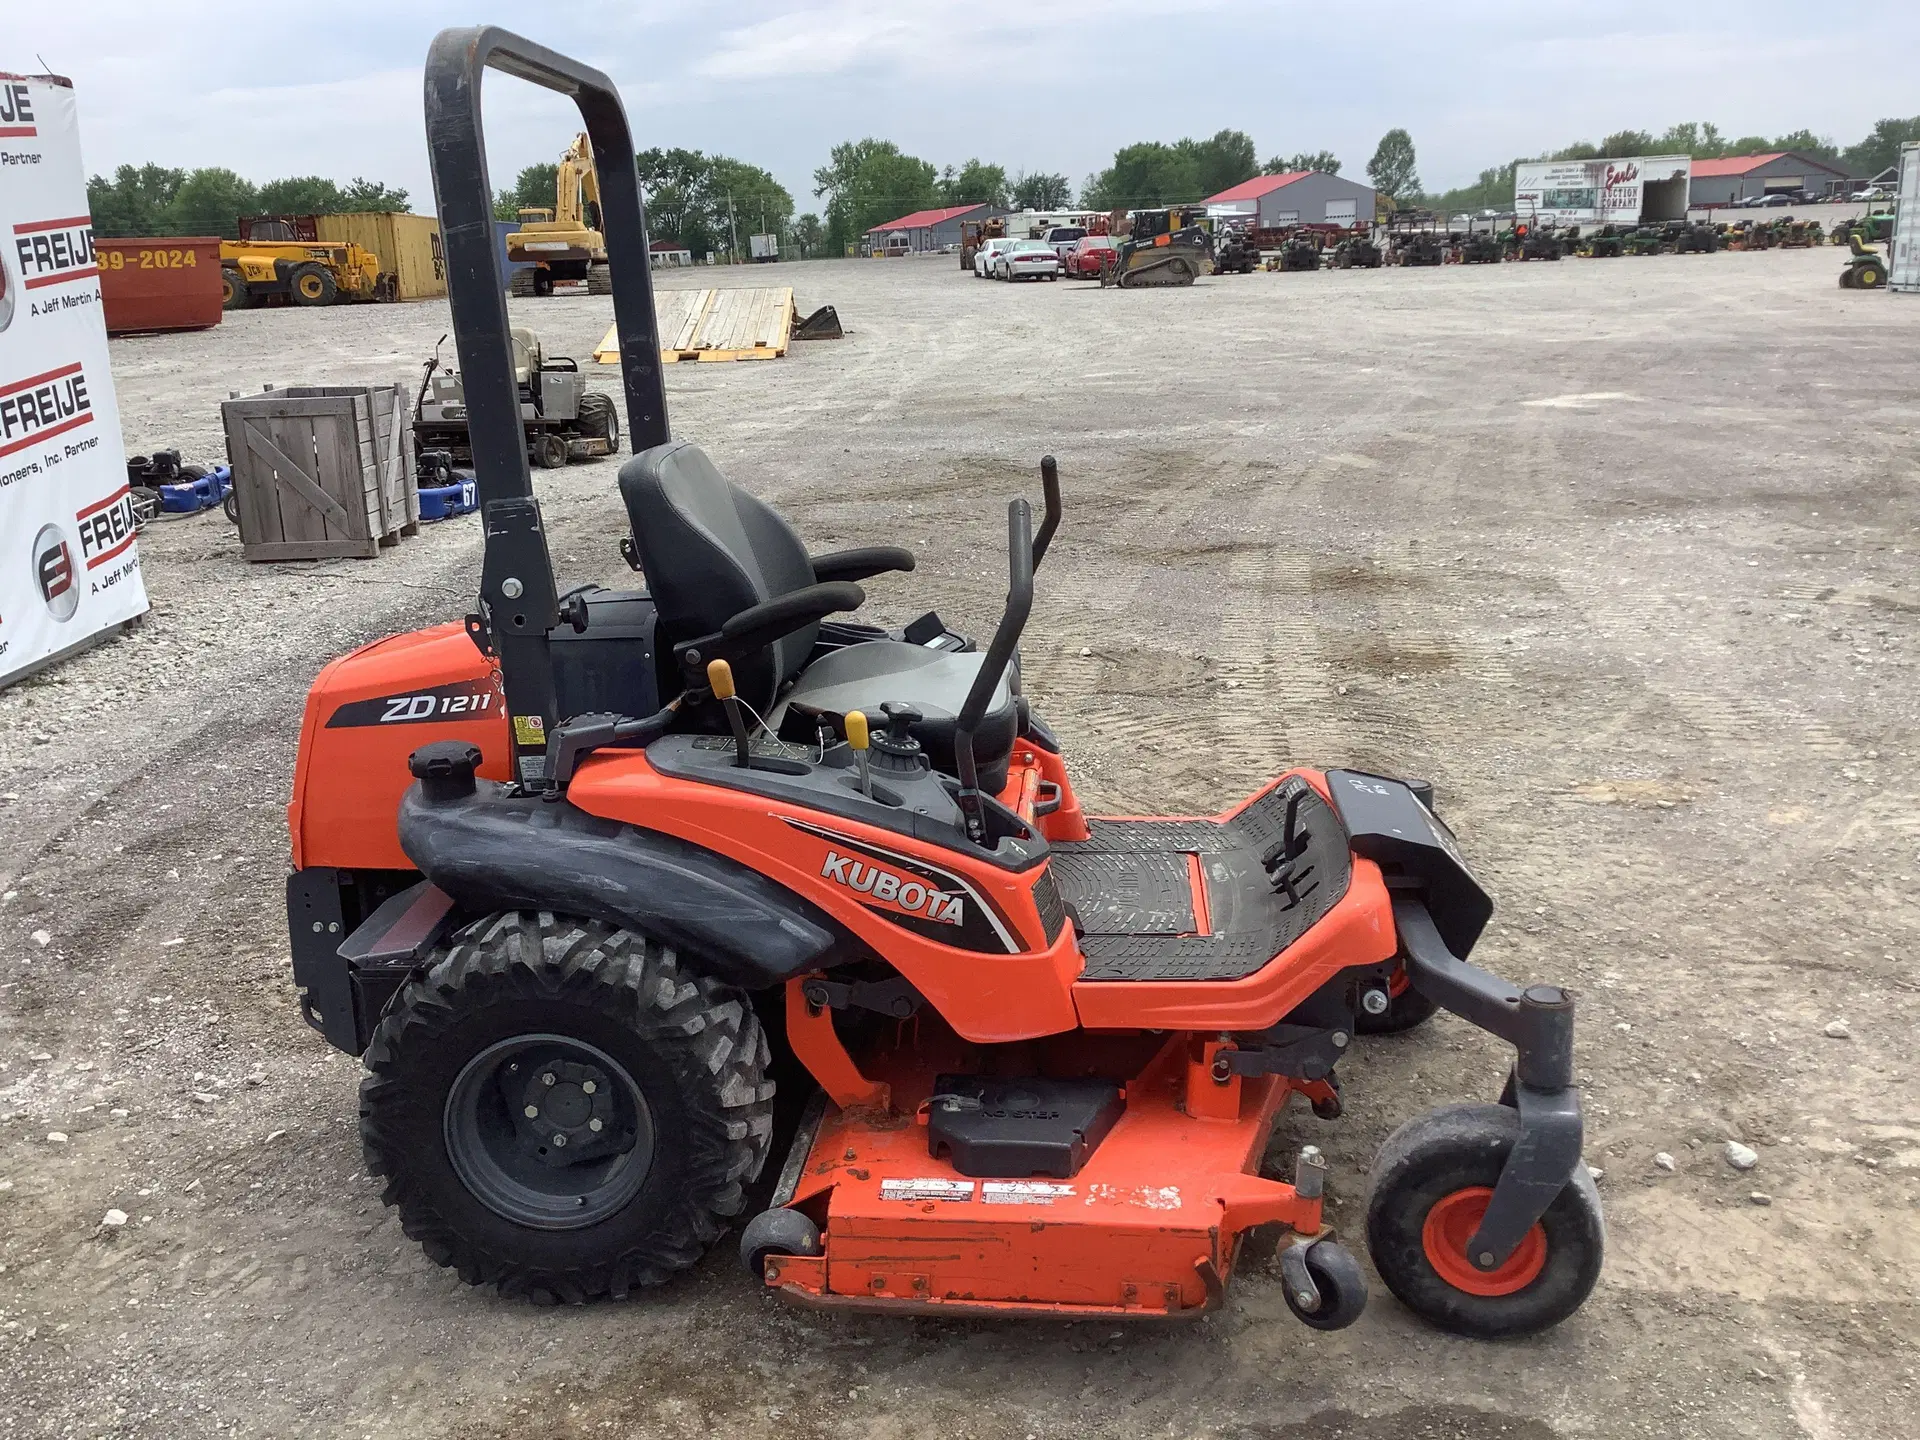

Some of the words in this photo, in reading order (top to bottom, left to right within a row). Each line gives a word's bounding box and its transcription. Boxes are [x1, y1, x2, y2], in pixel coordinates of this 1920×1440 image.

[1, 151, 42, 165] Partner
[1602, 188, 1638, 198] AUCTION
[1602, 198, 1637, 208] COMPANY
[247, 265, 262, 277] JCB
[31, 303, 40, 317] A
[41, 298, 60, 314] Jeff
[61, 292, 92, 309] Martin
[0, 375, 91, 439] FREIJE
[44, 453, 62, 468] Inc.
[64, 436, 99, 459] Partner
[462, 482, 476, 507] 67
[91, 582, 99, 596] A
[101, 568, 122, 589] Jeff
[380, 696, 437, 722] ZD
[440, 692, 492, 714] 1211
[820, 850, 964, 927] KUBOTA
